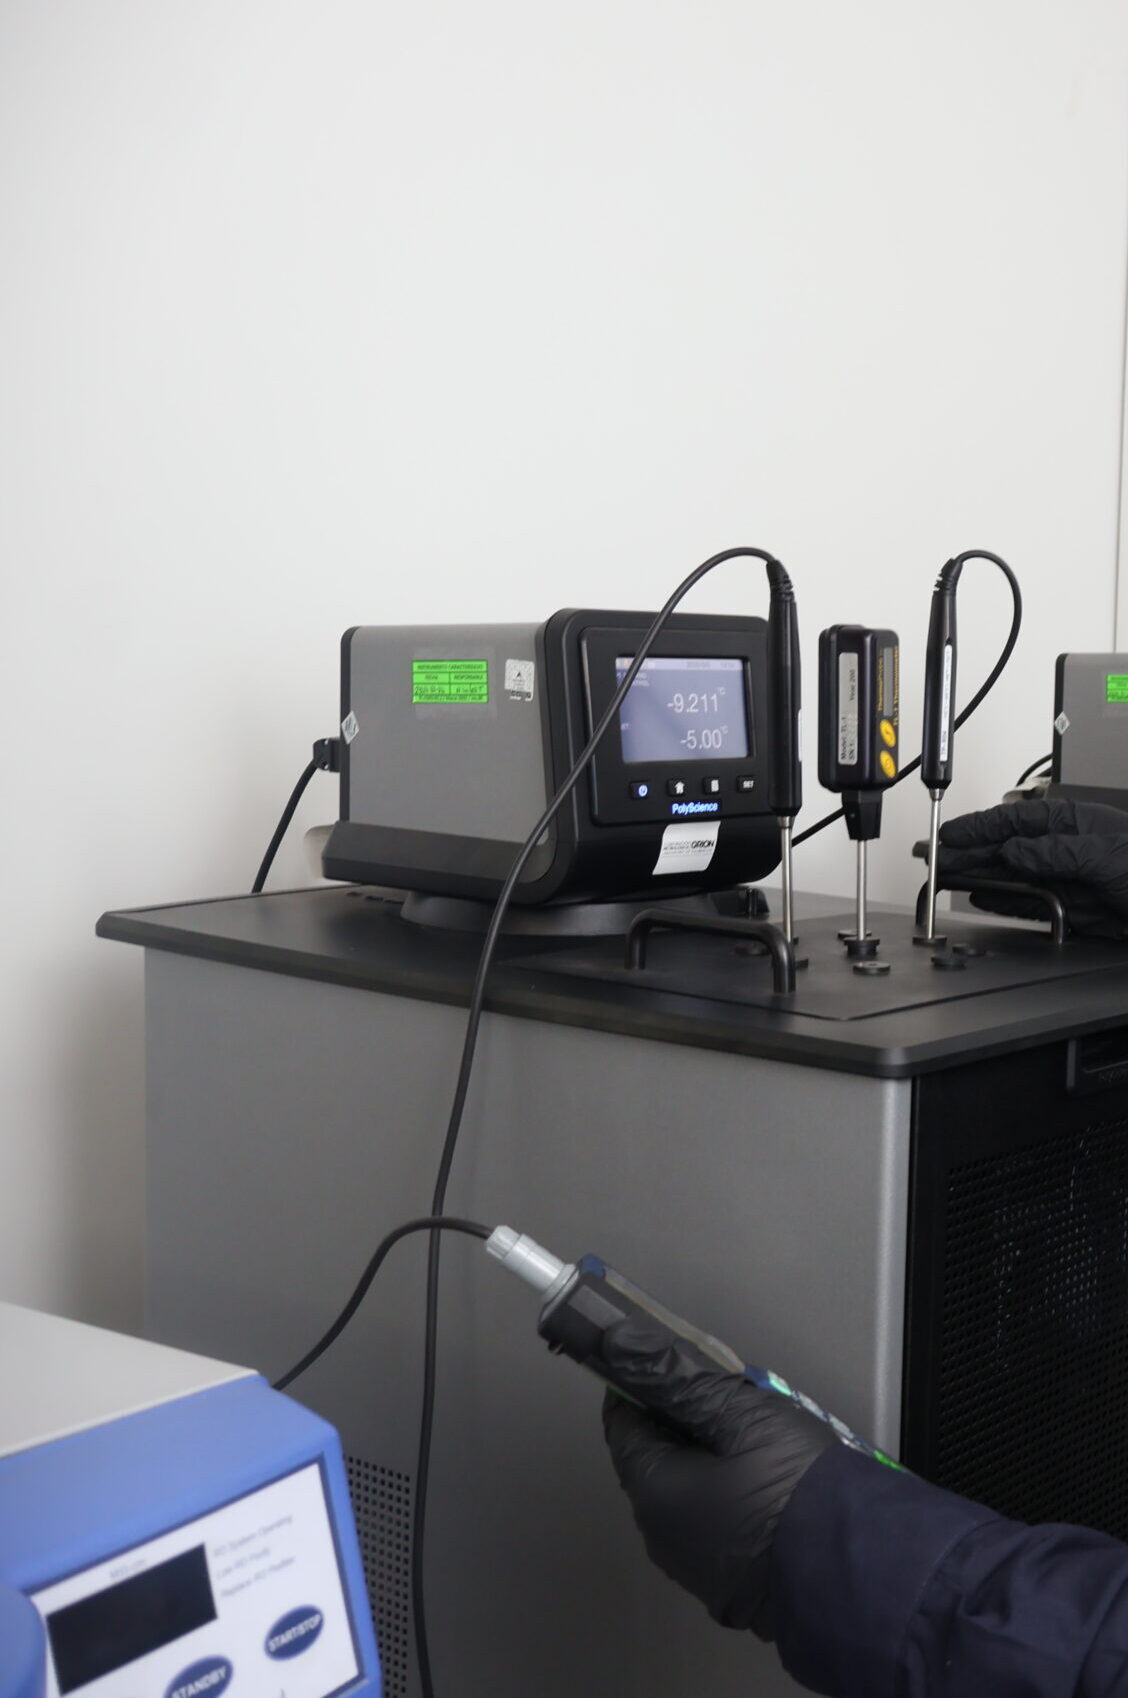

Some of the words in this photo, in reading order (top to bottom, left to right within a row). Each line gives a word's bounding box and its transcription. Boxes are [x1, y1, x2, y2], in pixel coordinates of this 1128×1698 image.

[667, 692, 718, 713] -9.211
[680, 728, 722, 749] -5.00
[672, 802, 718, 815] PolyScience
